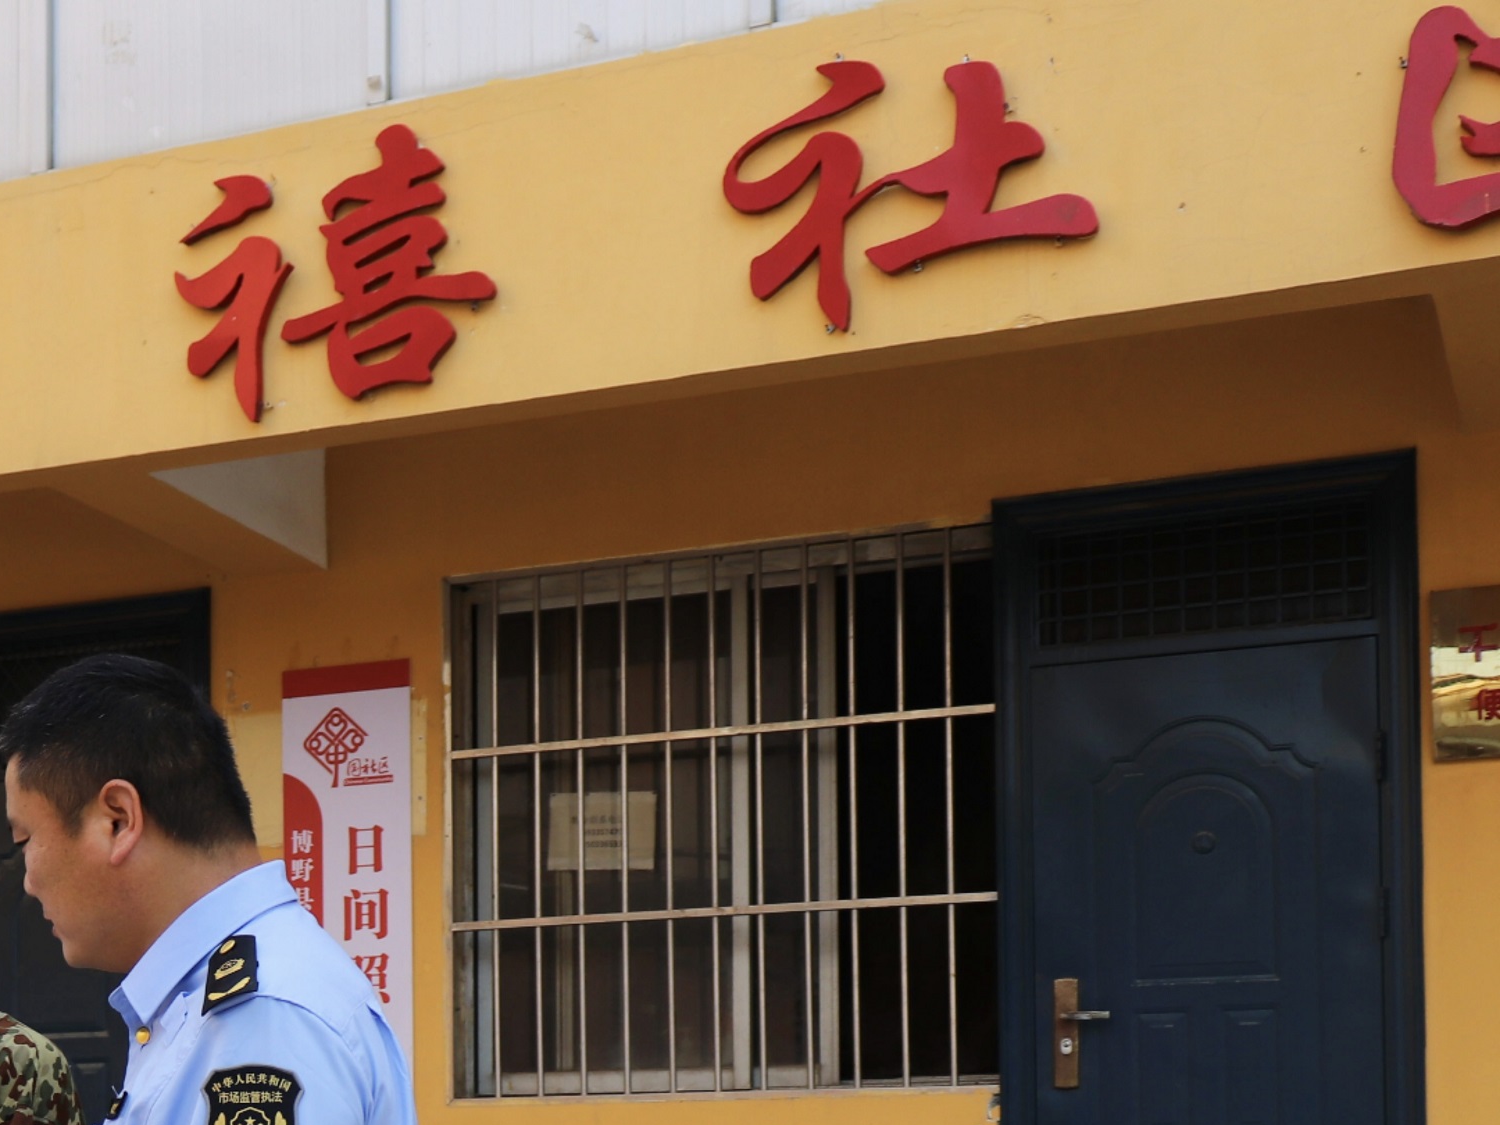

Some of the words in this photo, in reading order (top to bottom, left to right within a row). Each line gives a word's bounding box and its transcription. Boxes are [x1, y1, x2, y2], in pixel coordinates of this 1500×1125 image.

[211, 1073, 292, 1093] 中华人民共和国
[218, 1091, 283, 1104] 市场监管执法
